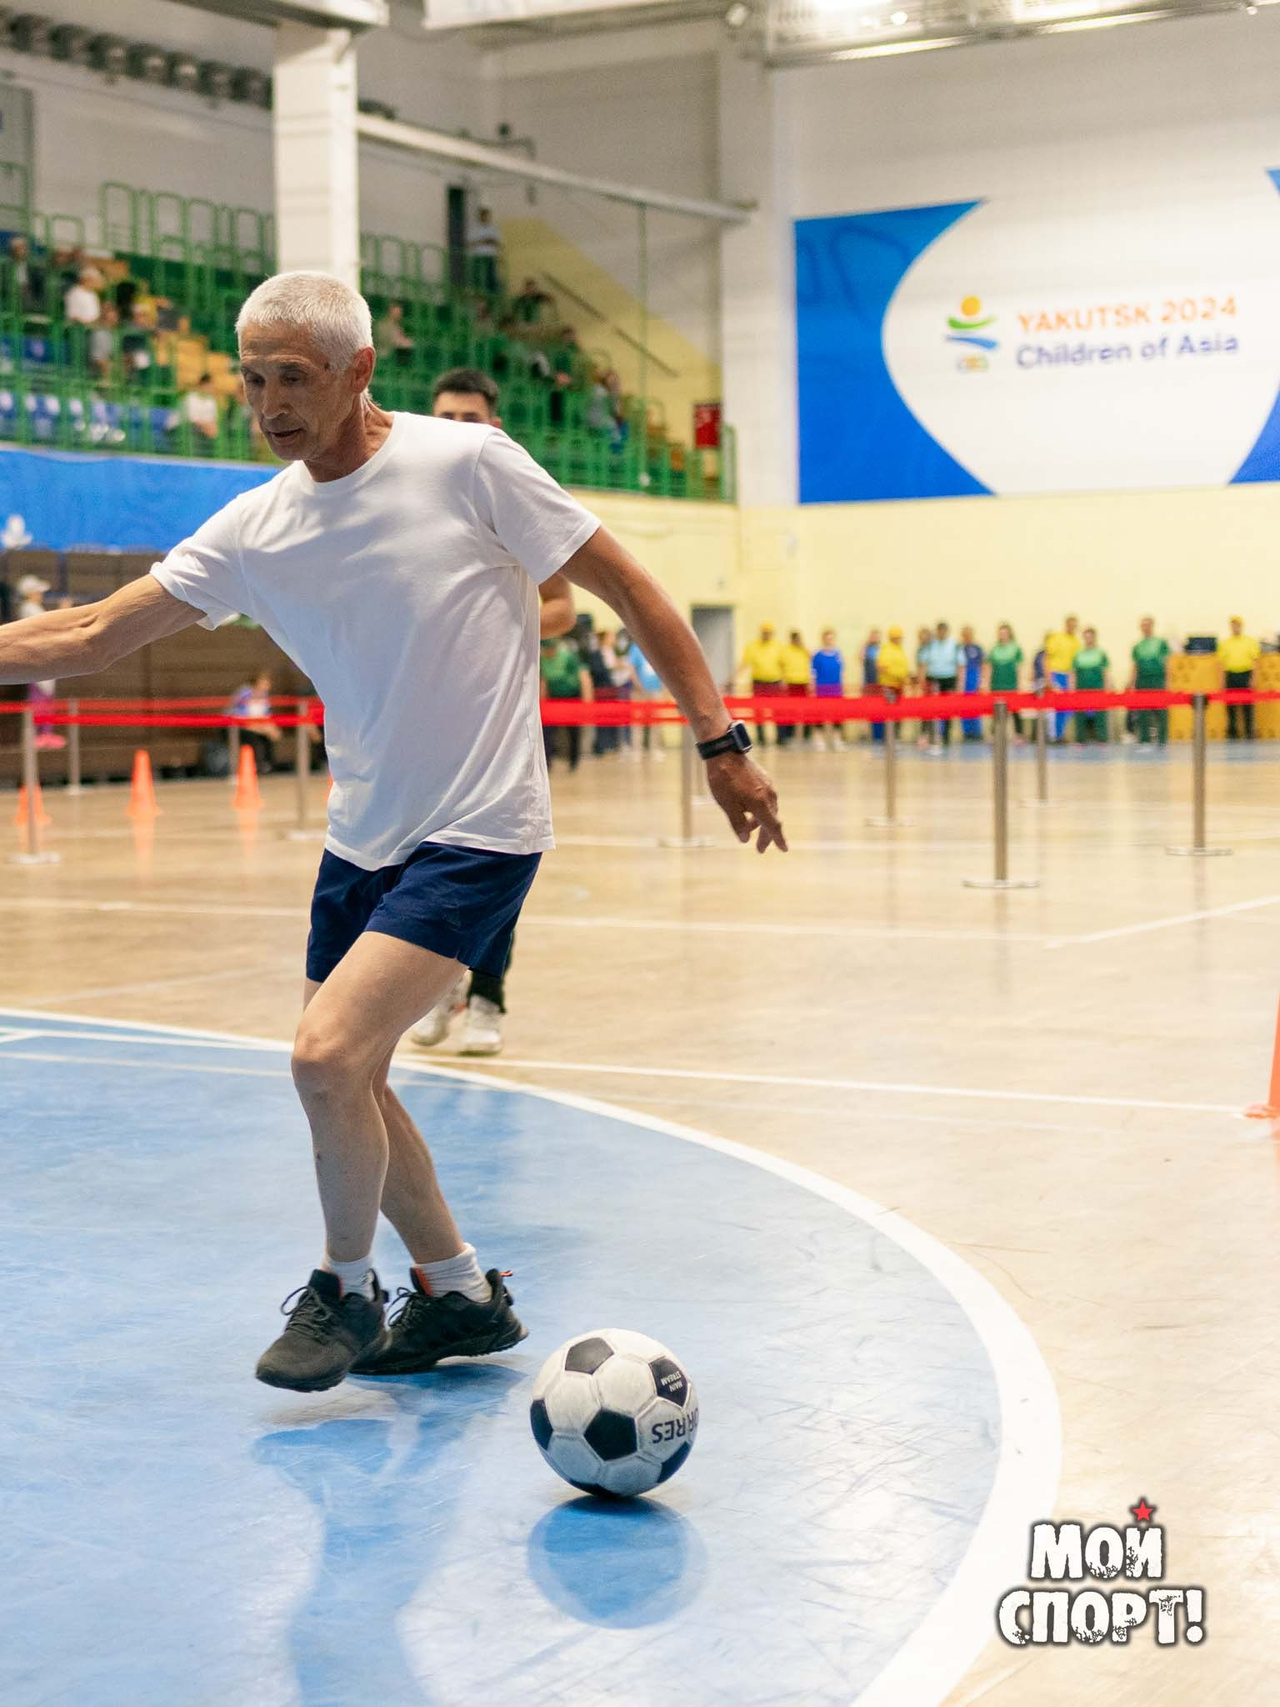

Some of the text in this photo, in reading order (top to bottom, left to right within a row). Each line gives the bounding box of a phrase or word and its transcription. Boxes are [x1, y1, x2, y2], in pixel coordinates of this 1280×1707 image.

[1017, 296, 1237, 332] YAKUTSK 2024
[1017, 332, 1238, 369] Children of Asia
